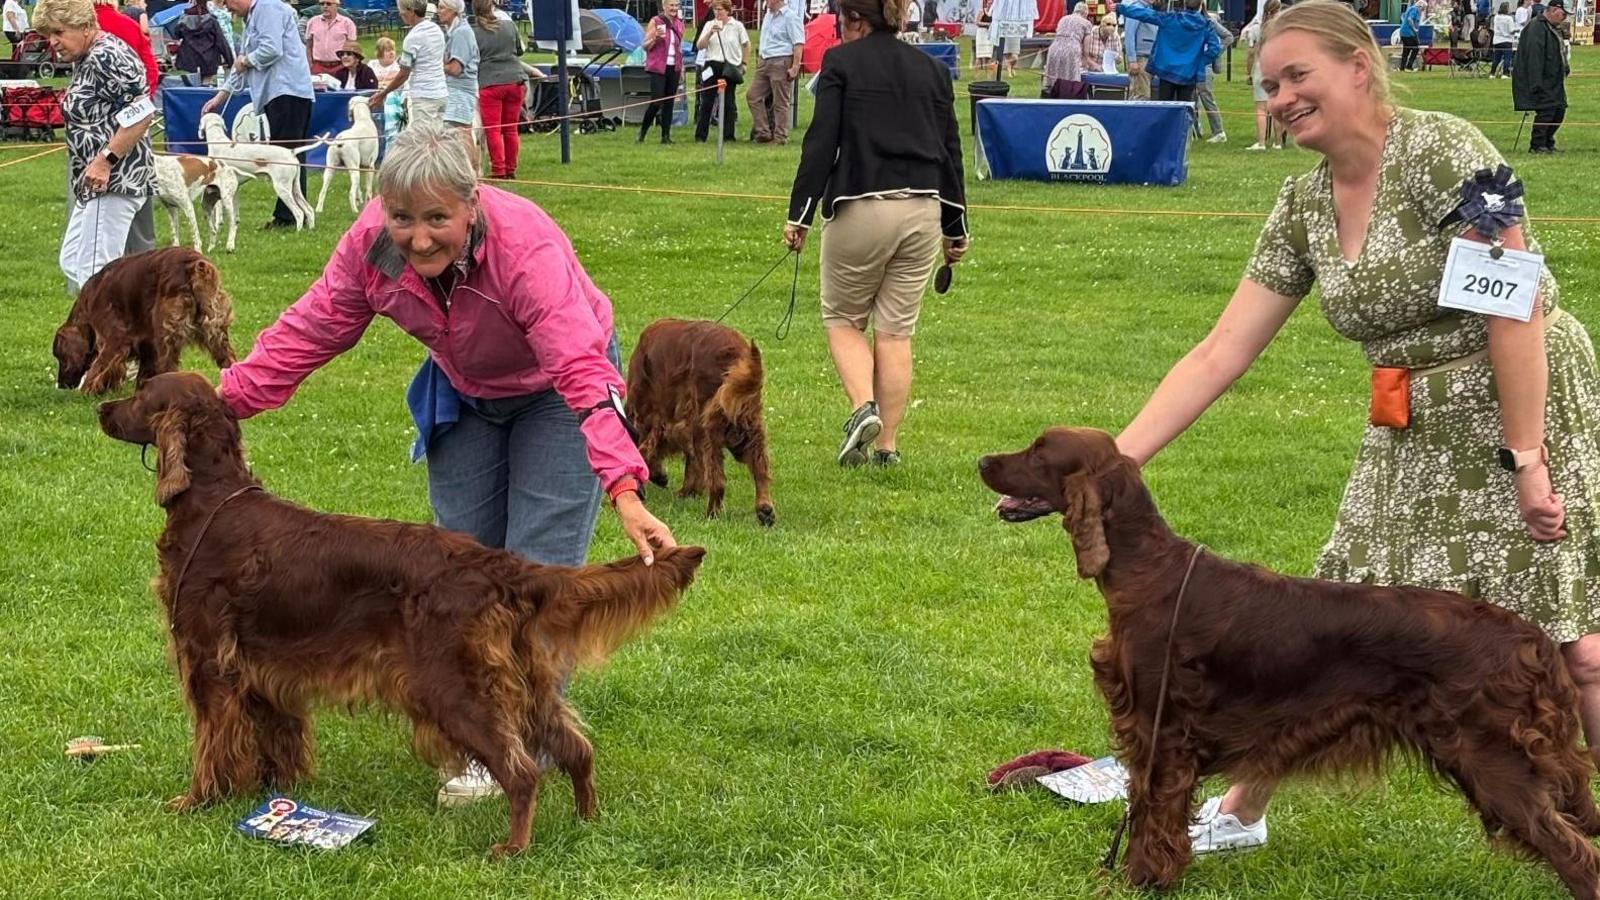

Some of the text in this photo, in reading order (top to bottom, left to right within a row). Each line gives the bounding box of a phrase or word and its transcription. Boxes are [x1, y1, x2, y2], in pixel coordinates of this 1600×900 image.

[124, 103, 145, 119] 2901
[1050, 173, 1104, 181] BLACKPOOL
[1462, 273, 1518, 300] 2907
